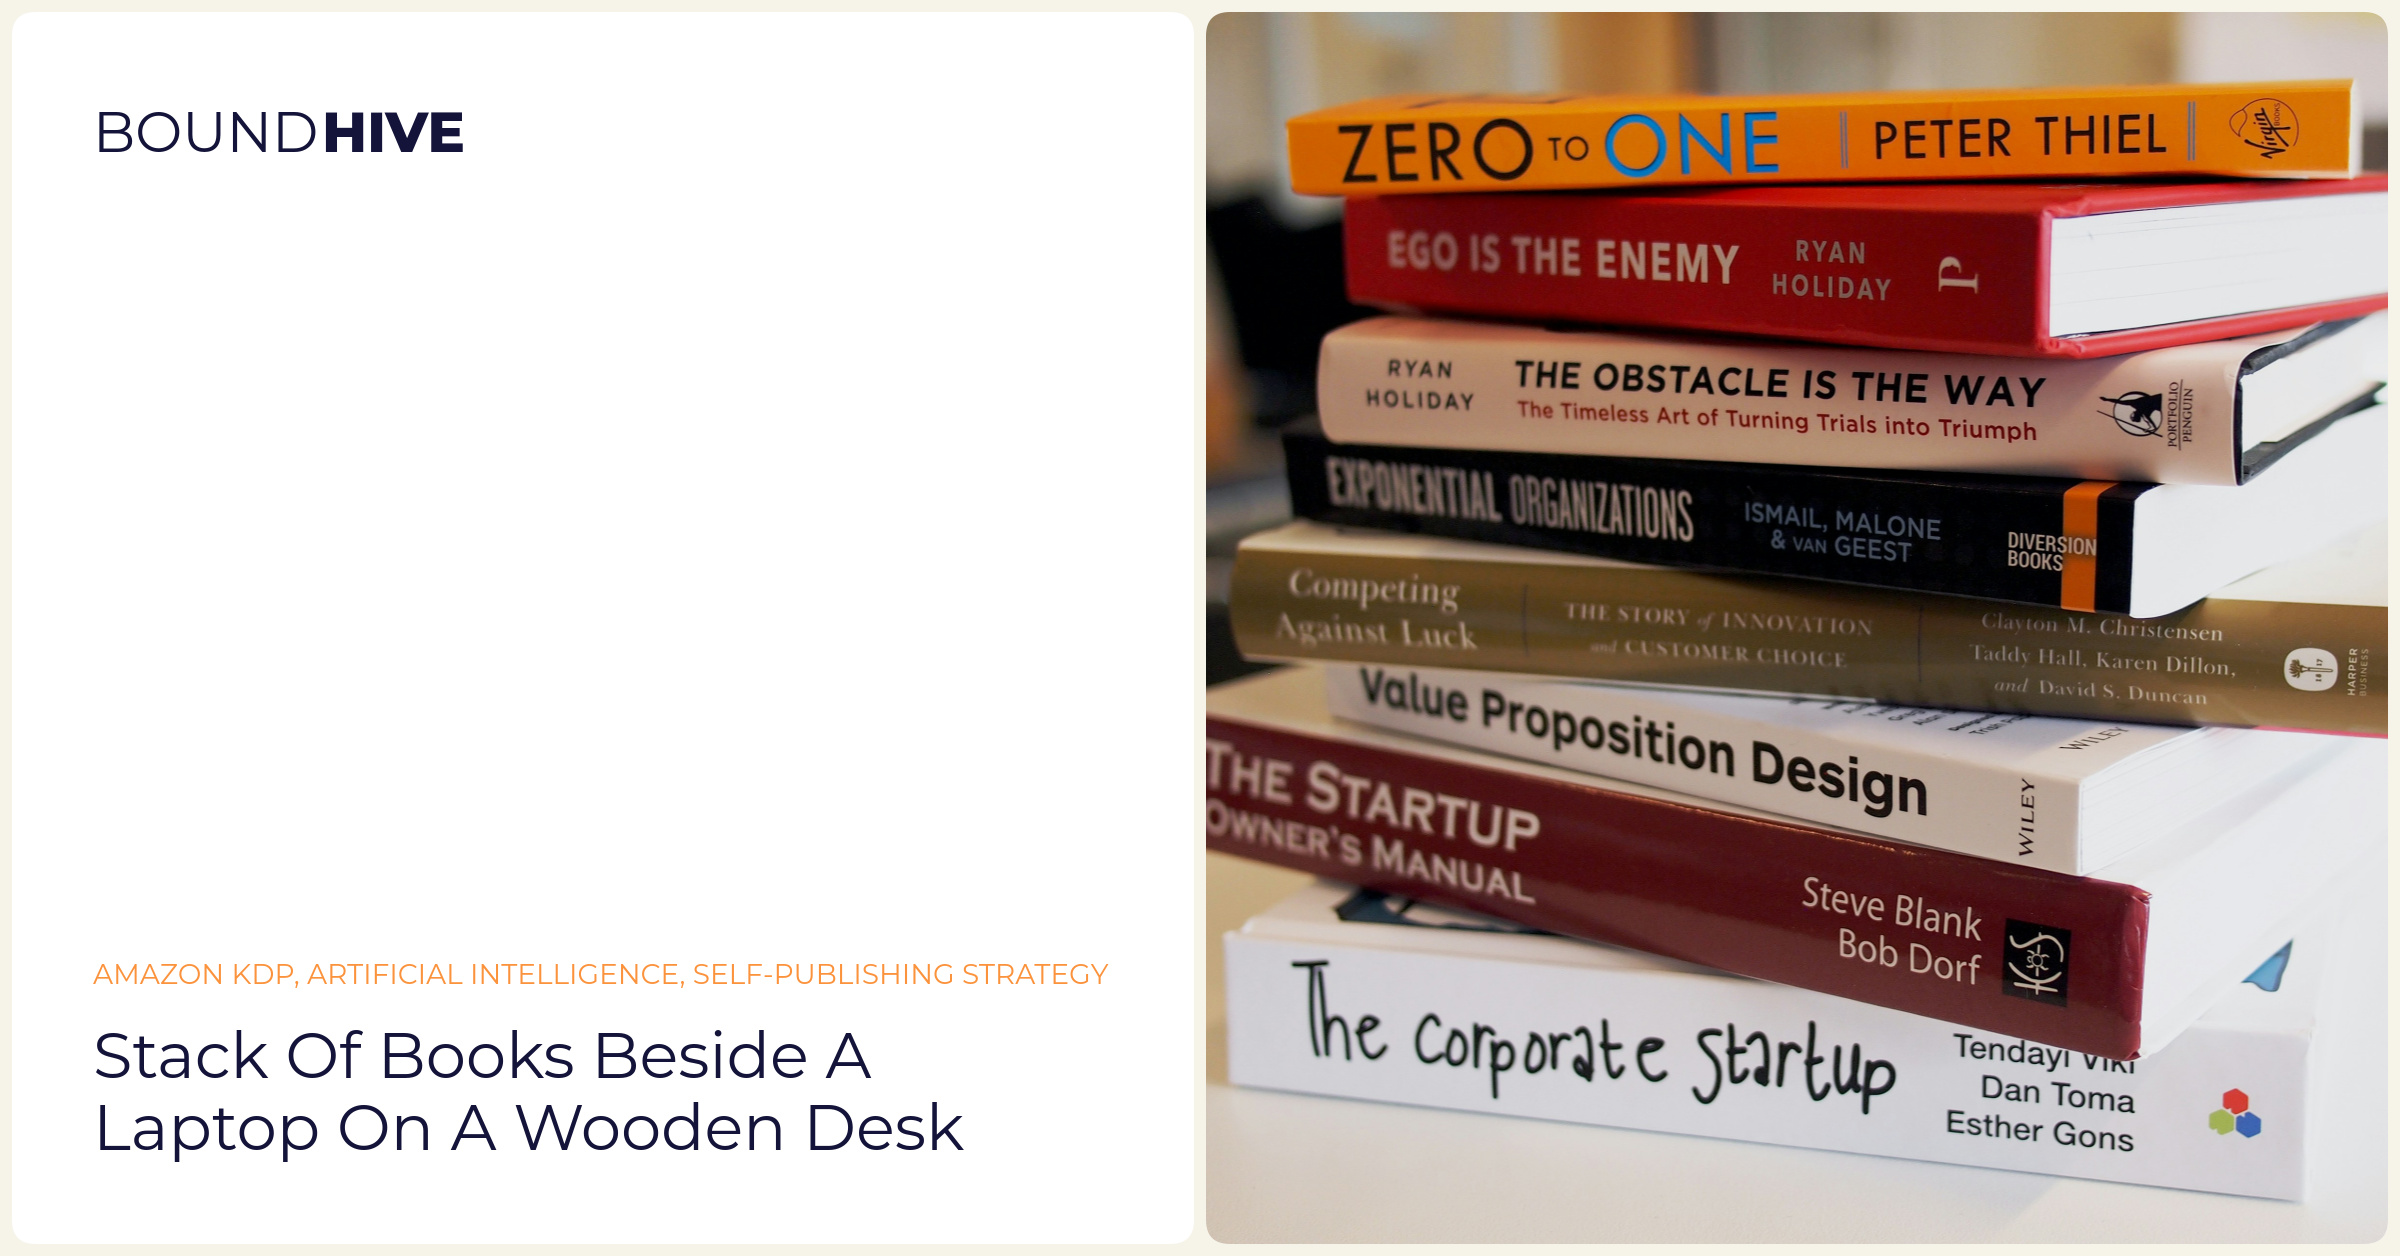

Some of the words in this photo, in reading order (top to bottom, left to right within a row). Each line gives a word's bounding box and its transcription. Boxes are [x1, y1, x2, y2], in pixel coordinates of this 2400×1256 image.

[2244, 107, 2291, 159] Virgin
[2273, 102, 2281, 127] BOOKS
[1338, 118, 1534, 184] ZERO
[1548, 136, 1589, 161] TO
[1605, 111, 1779, 178] ONE
[1875, 118, 2011, 160] PETER
[2034, 113, 2167, 156] THIEL
[1388, 231, 1458, 271] EGO
[1470, 234, 1500, 273] IS
[1511, 236, 1581, 276] THE
[1597, 240, 1740, 284] ENEMY
[1796, 240, 1865, 264] RYAN
[1772, 273, 1891, 300] HOLIDAY
[1388, 359, 1453, 380] RYAN
[1515, 361, 1581, 389] THE
[1593, 363, 1789, 397] OBSTACLE
[1803, 370, 1837, 399] IS
[1852, 372, 1929, 403] THE
[1944, 375, 2047, 407] WAY
[1366, 389, 1474, 412] HOLIDAY
[1518, 401, 1553, 419] The
[1560, 402, 1649, 423] Timeless
[1657, 407, 1689, 425] Art
[1697, 408, 1718, 426] of
[1726, 410, 1808, 433] Turning
[1817, 414, 1877, 434] Trials
[1885, 416, 1930, 436] into
[1938, 419, 2037, 443] Triumph
[2167, 381, 2179, 448] PORTFOLIO
[2182, 388, 2193, 442] PENGUIN
[1325, 456, 1502, 523] EXPONENTIAL
[1509, 474, 1694, 542] ORGANIZATIONS
[1745, 502, 1828, 533] ISMAIL,
[1836, 511, 1941, 541] MALONE
[1770, 530, 1786, 550] &
[1793, 537, 1827, 554] VAN
[1835, 536, 1912, 563] GEEST
[2008, 532, 2097, 556] DIVERSION
[2008, 551, 2063, 571] BOOKS
[1289, 568, 1460, 615] Competing
[1276, 612, 1388, 648] Against
[1402, 619, 1478, 650] Luck
[1565, 602, 1610, 622] THE
[1617, 605, 1690, 626] STORY
[1697, 612, 1715, 632] of
[1723, 612, 1873, 636] INNOVATION
[1981, 613, 2057, 634] Clayton
[2066, 617, 2090, 634] M.
[2100, 619, 2223, 641] Christensen
[1590, 639, 1617, 653] and
[1624, 640, 1750, 662] CUSTOMER
[1757, 648, 1847, 667] CHOICE
[1969, 644, 2031, 667] Taddy
[2039, 648, 2087, 668] Hall,
[2097, 652, 2158, 671] Karen
[2166, 656, 2236, 677] Dillon,
[2347, 648, 2358, 696] HARPER
[2359, 648, 2369, 697] BUSINESS
[1994, 678, 2029, 693] and
[2040, 680, 2096, 698] David
[2103, 684, 2120, 699] S.
[2129, 686, 2207, 705] Duncan
[1360, 666, 1467, 721] Value
[1481, 688, 1734, 777] Proposition
[1753, 740, 1927, 818] Design
[2059, 726, 2129, 750] WILEY
[1206, 738, 1293, 805] THE
[1307, 759, 1540, 852] STARTUP
[2018, 778, 2036, 857] WILEY
[1206, 797, 1362, 867] OWNER'S
[1371, 834, 1536, 904] MANUAL
[1802, 876, 1884, 921] Steve
[1895, 895, 1982, 941] Blank
[1839, 928, 1898, 967] Bob
[1909, 943, 1982, 985] Dorf
[1291, 960, 1388, 1061] The
[1982, 1074, 2040, 1103] Dan
[2051, 1081, 2136, 1113] Toma
[1946, 1109, 2043, 1142] Esther
[2053, 1121, 2135, 1152] Gons
